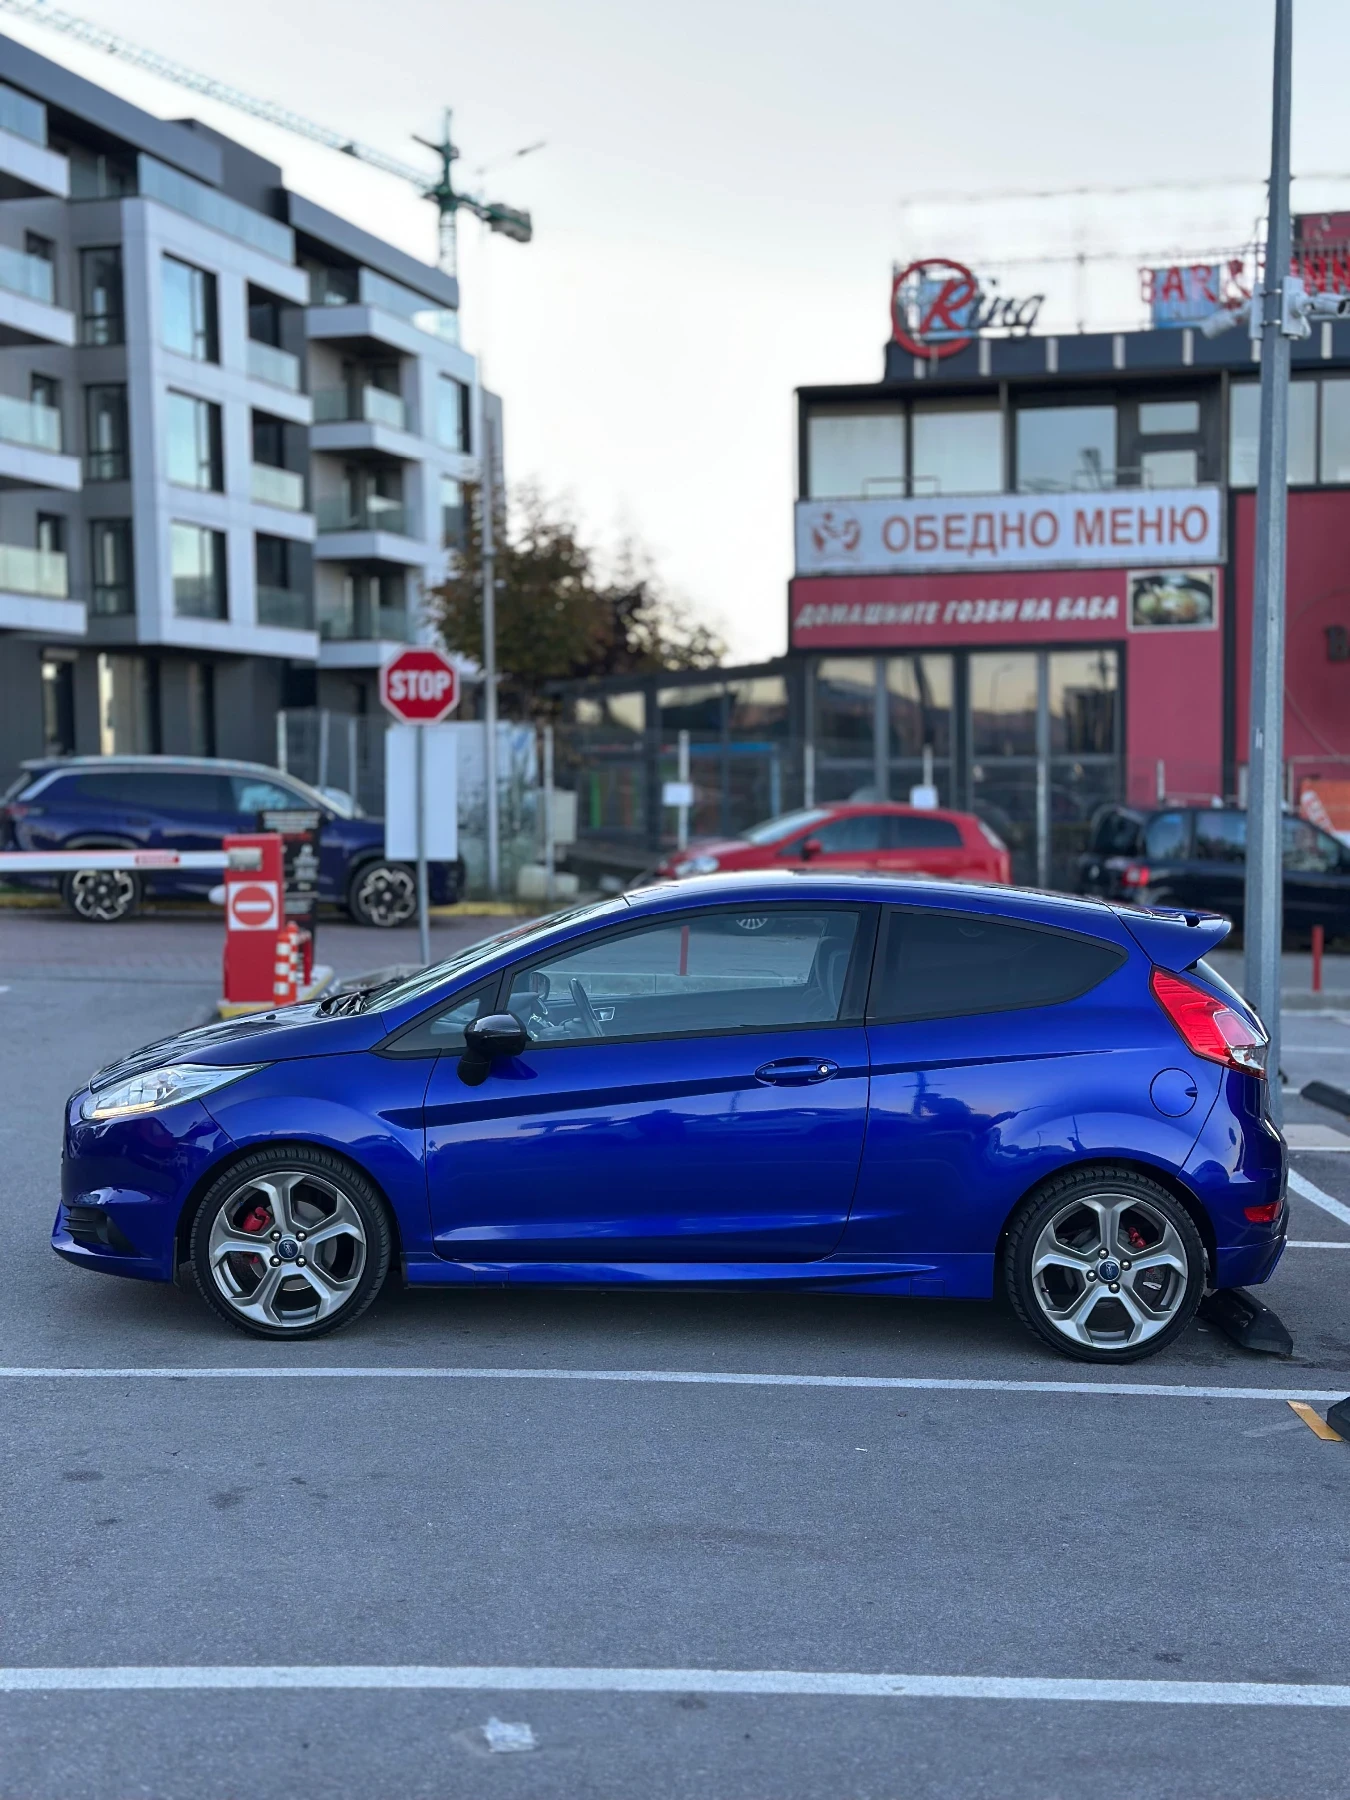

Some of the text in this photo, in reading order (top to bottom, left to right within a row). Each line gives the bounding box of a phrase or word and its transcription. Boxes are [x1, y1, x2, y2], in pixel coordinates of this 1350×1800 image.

[1138, 263, 1219, 304] BAR
[881, 505, 1210, 557] ОБЕДНО МЕНЮ
[389, 669, 452, 701] STOP
